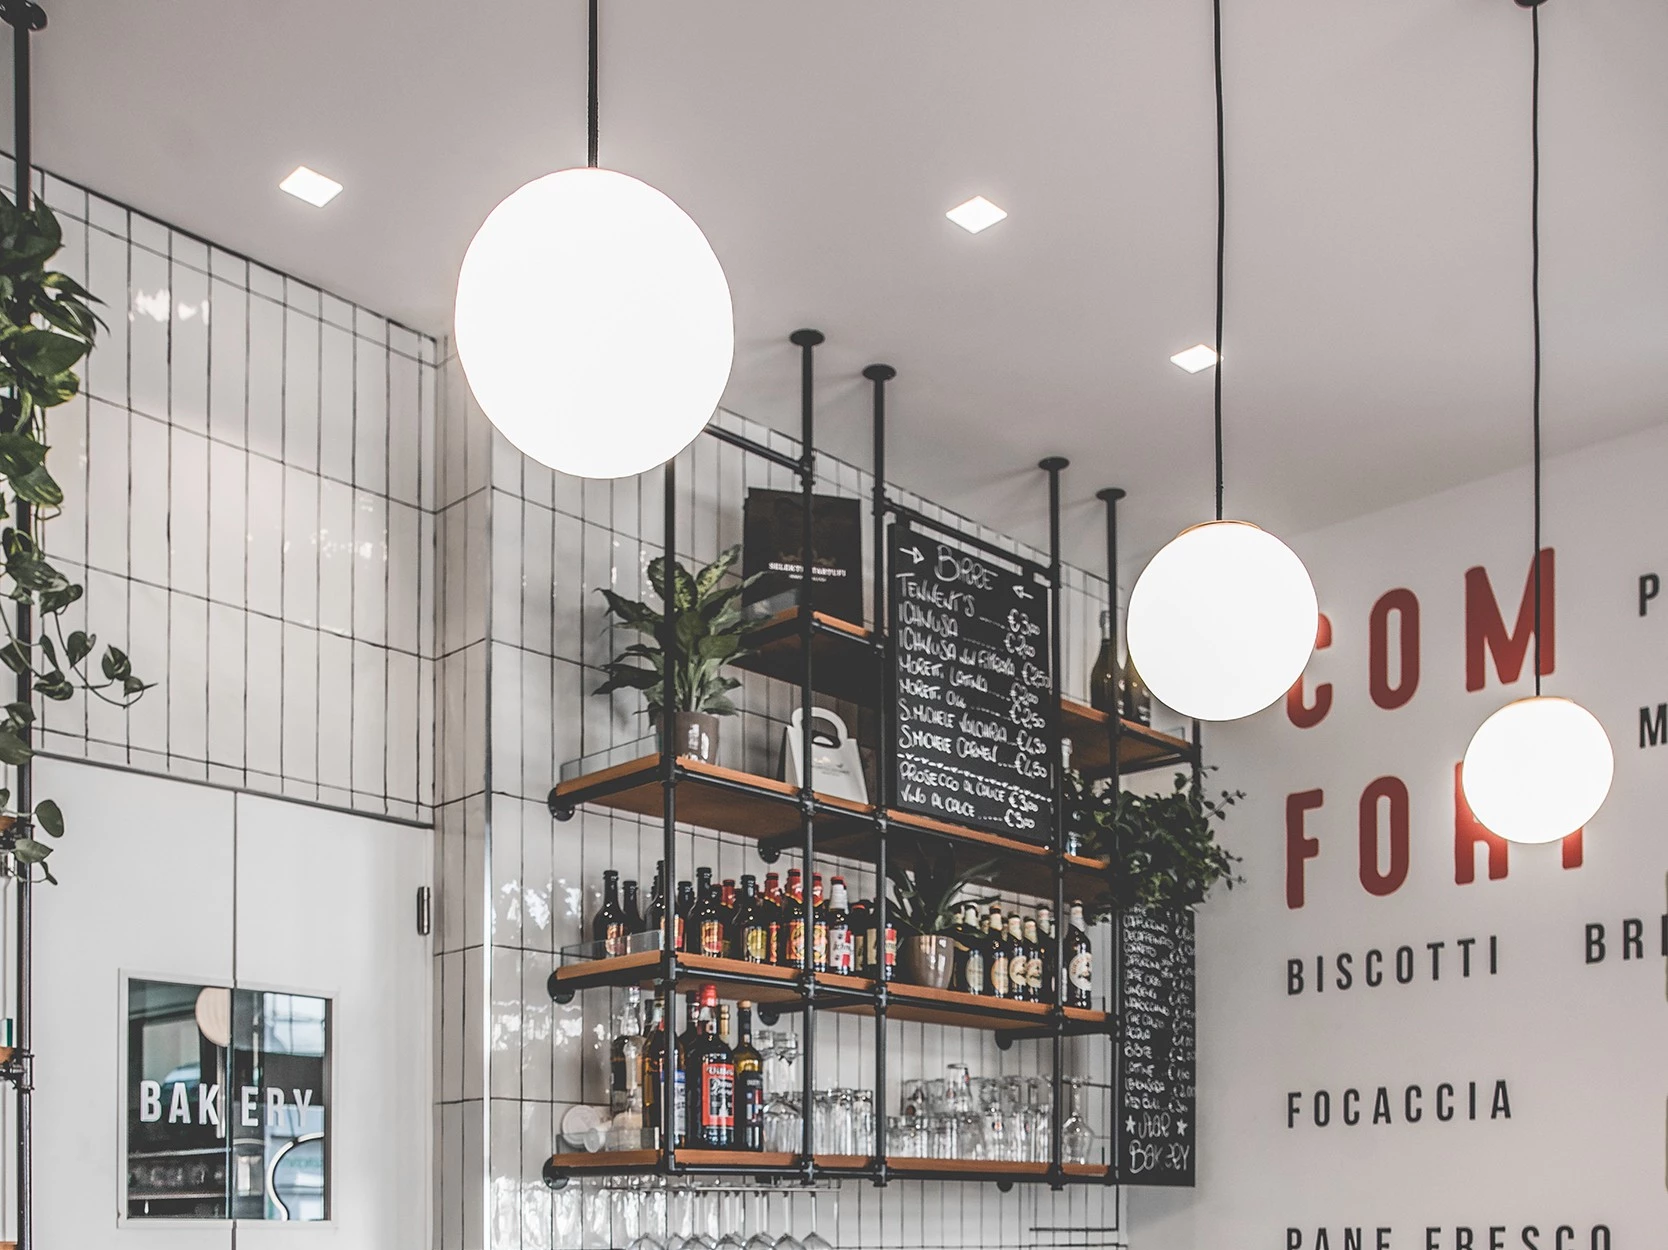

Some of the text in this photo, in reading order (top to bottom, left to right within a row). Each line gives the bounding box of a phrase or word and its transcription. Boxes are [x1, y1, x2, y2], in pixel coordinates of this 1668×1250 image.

[934, 544, 998, 590] BIRRE
[895, 572, 975, 617] TENNENT'S
[898, 600, 959, 638] ICHNUSA
[898, 626, 957, 661] ICHNUSA
[899, 760, 960, 792] PROSECCO
[1286, 761, 1583, 909] FOR
[1287, 935, 1499, 996] BISCOTTI
[140, 1080, 313, 1127] BAKERY
[1287, 1081, 1512, 1129] FOCACCIA
